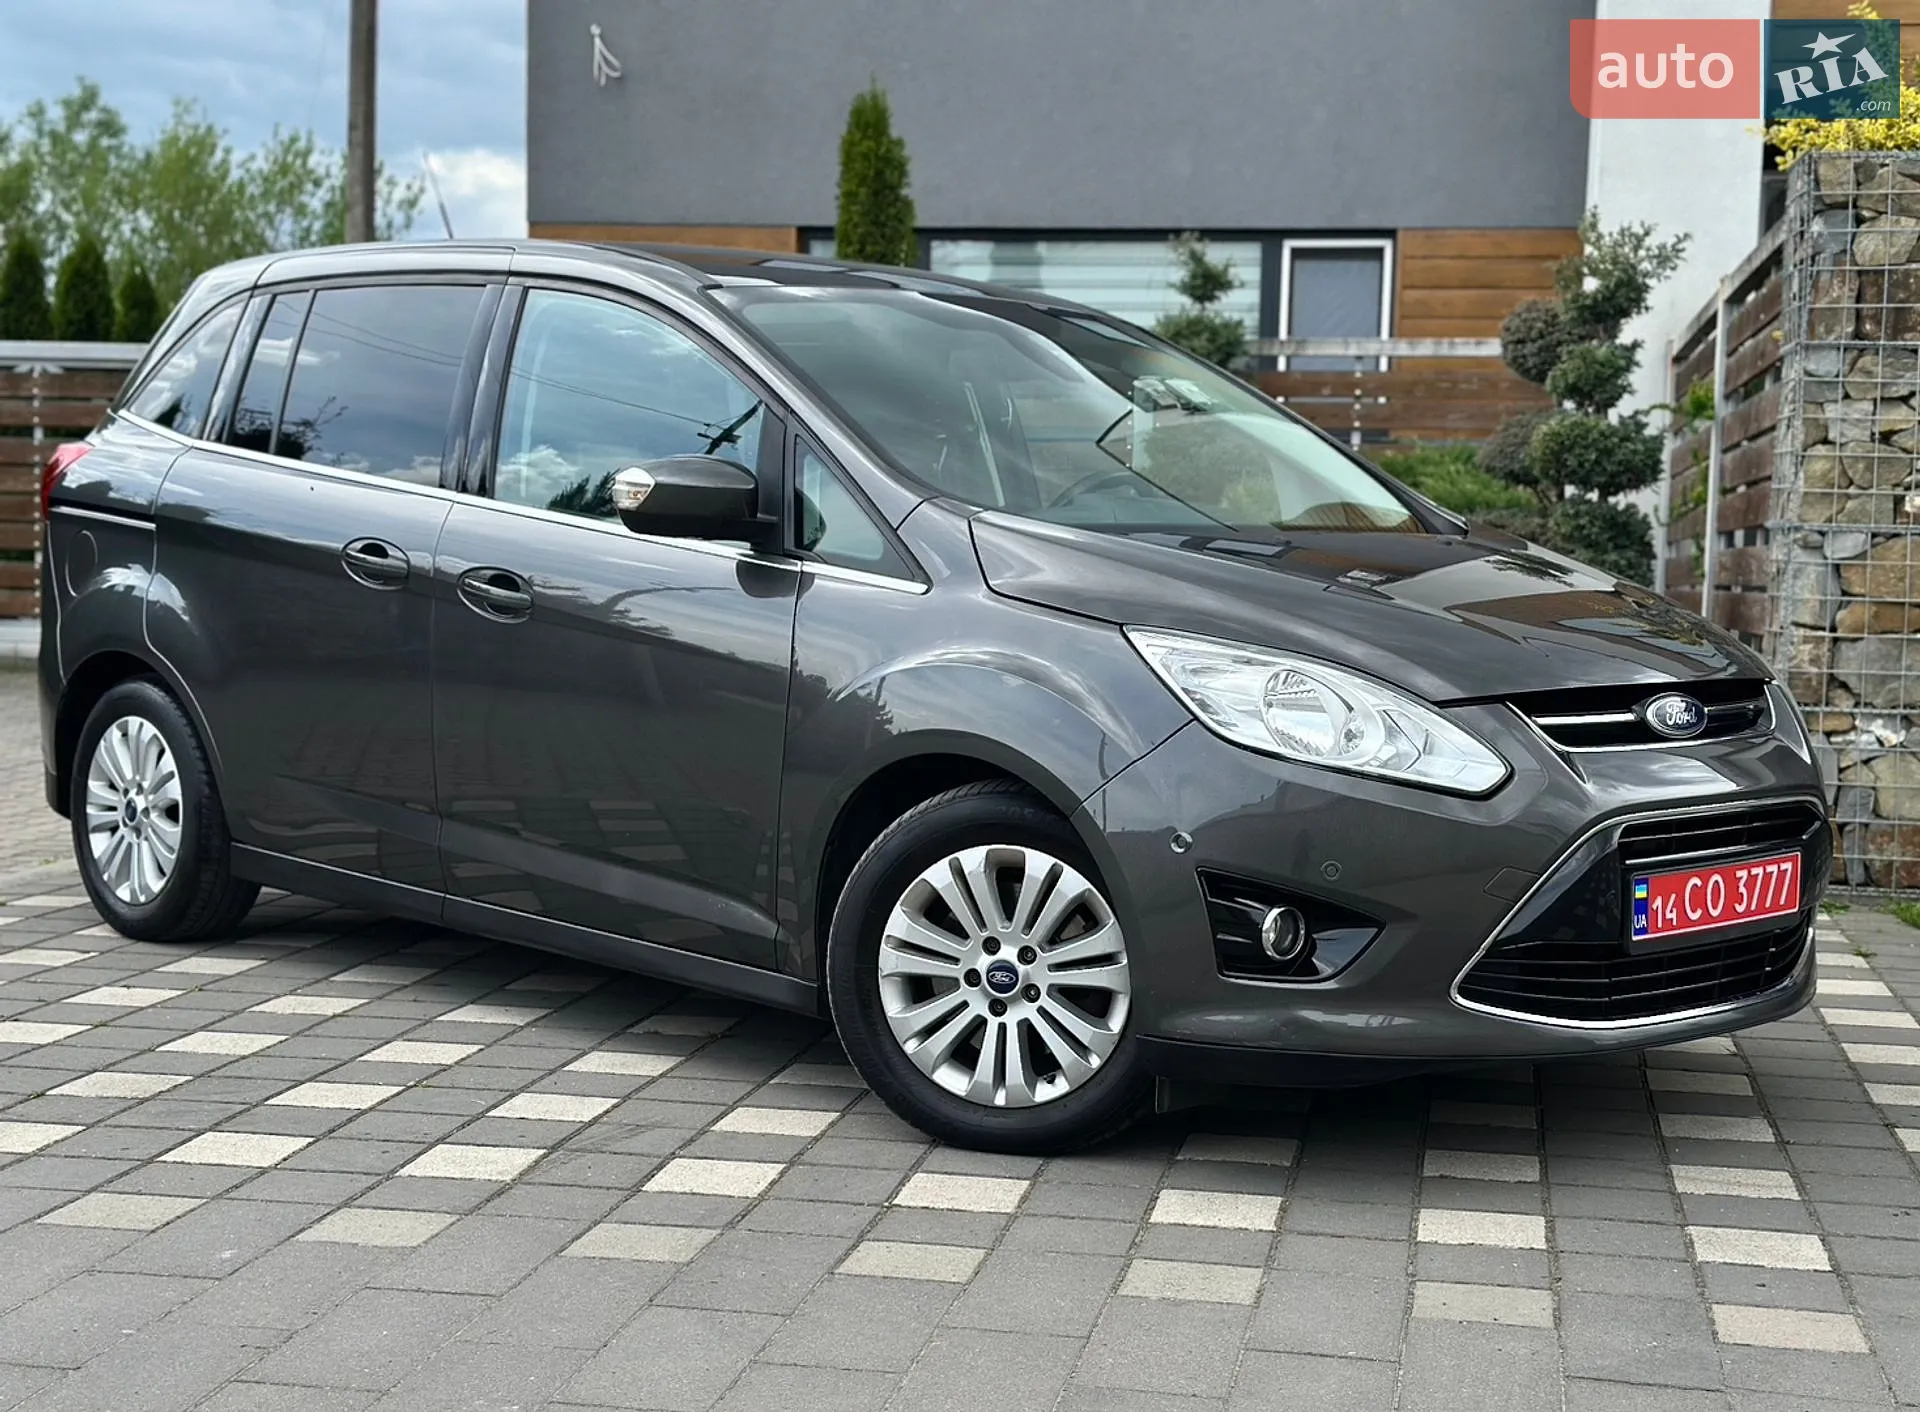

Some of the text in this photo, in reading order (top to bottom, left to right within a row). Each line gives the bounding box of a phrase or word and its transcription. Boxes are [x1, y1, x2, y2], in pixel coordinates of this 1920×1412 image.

[1666, 701, 1698, 725] Ford
[1684, 875, 1725, 920] CO
[1734, 861, 1792, 913] 3777
[1633, 914, 1647, 929] UA
